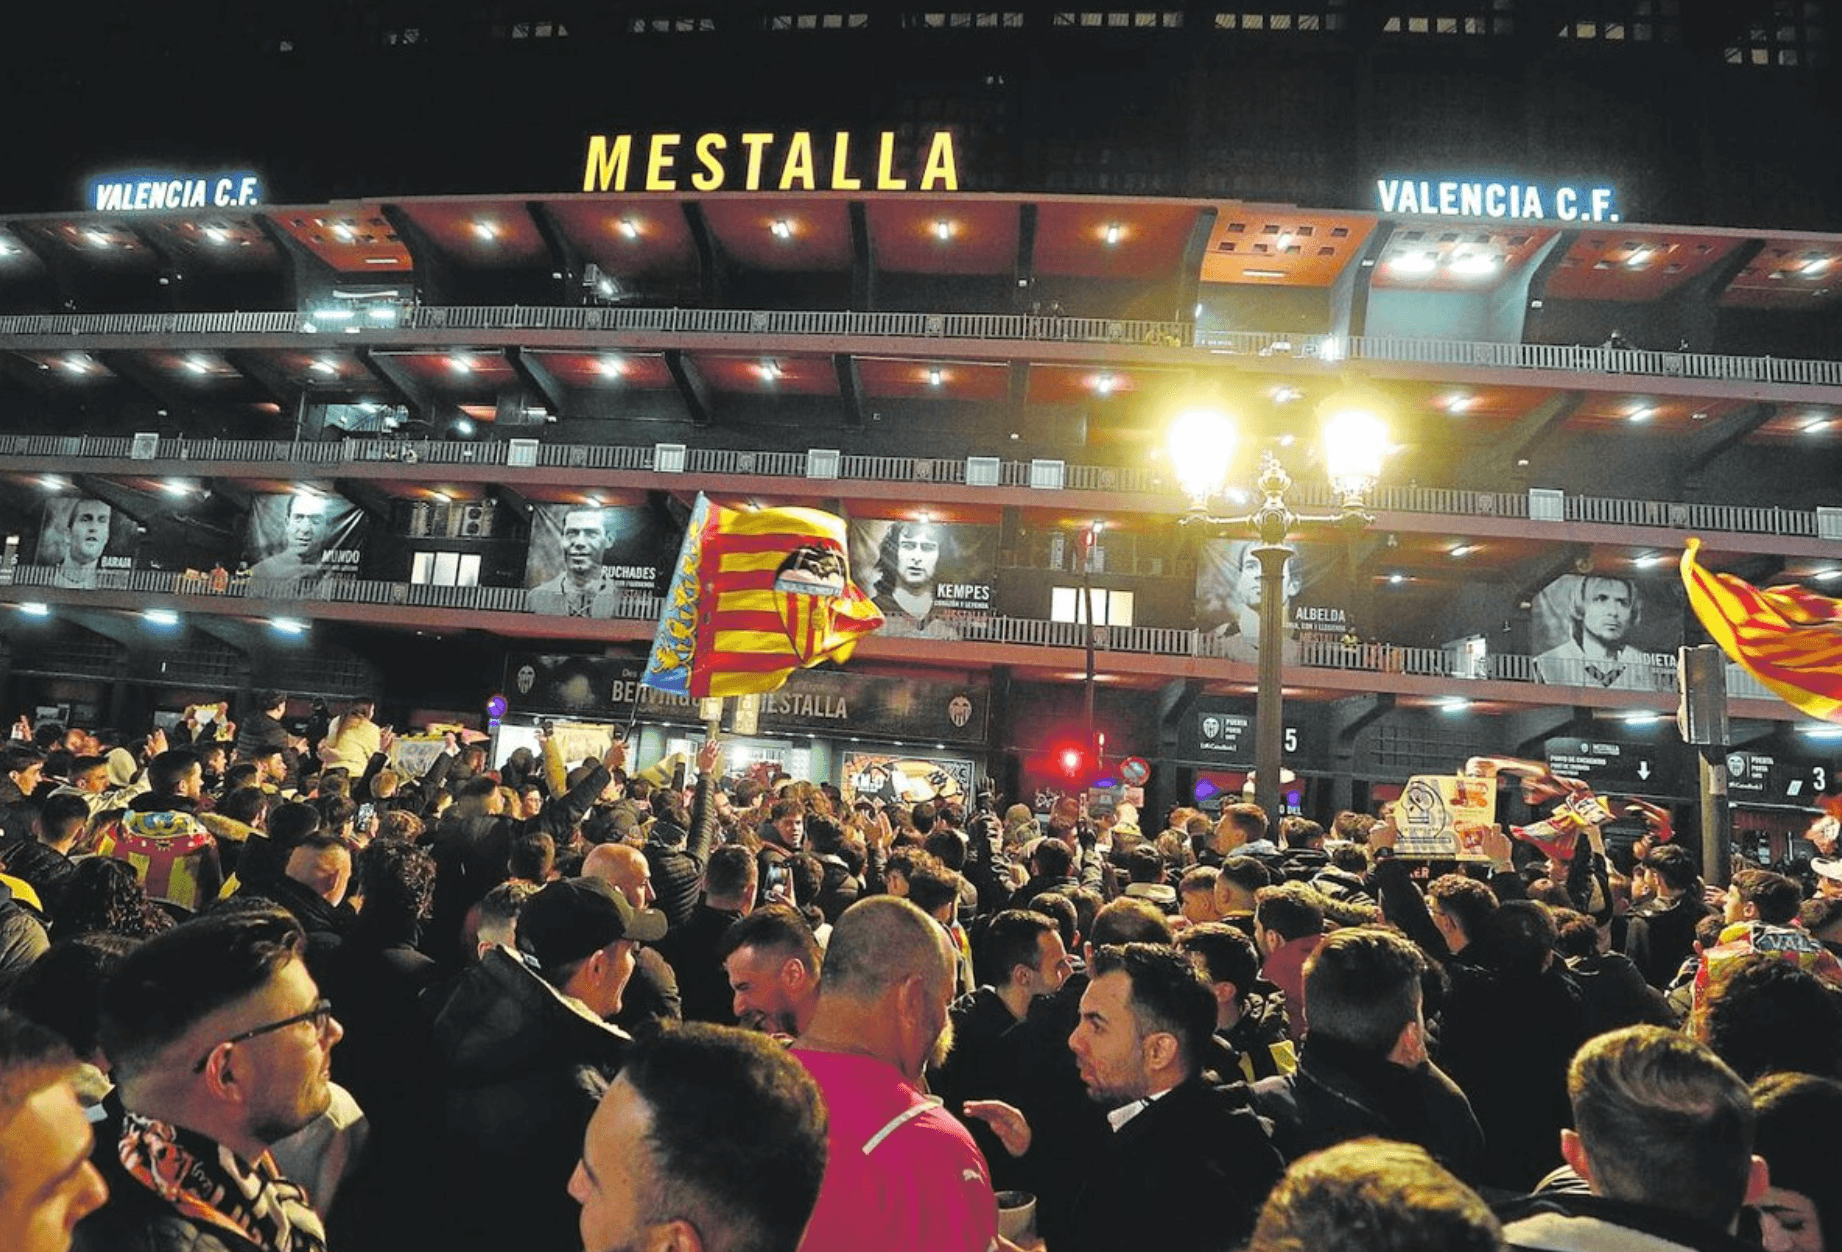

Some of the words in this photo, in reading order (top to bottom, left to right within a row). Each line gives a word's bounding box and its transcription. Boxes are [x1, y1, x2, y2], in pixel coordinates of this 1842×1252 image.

[582, 131, 959, 191] MESTALLA
[96, 179, 207, 211] VALENCIA
[214, 177, 258, 208] C.F.
[1377, 179, 1544, 219] VALENCIA
[1556, 187, 1620, 222] C.F.
[321, 549, 361, 564] MUNDO
[600, 565, 657, 580] PUCHADES
[937, 583, 990, 600] KEMPES
[1296, 606, 1346, 622] ALBELDA
[1284, 728, 1297, 752] 5
[1812, 766, 1826, 791] 3
